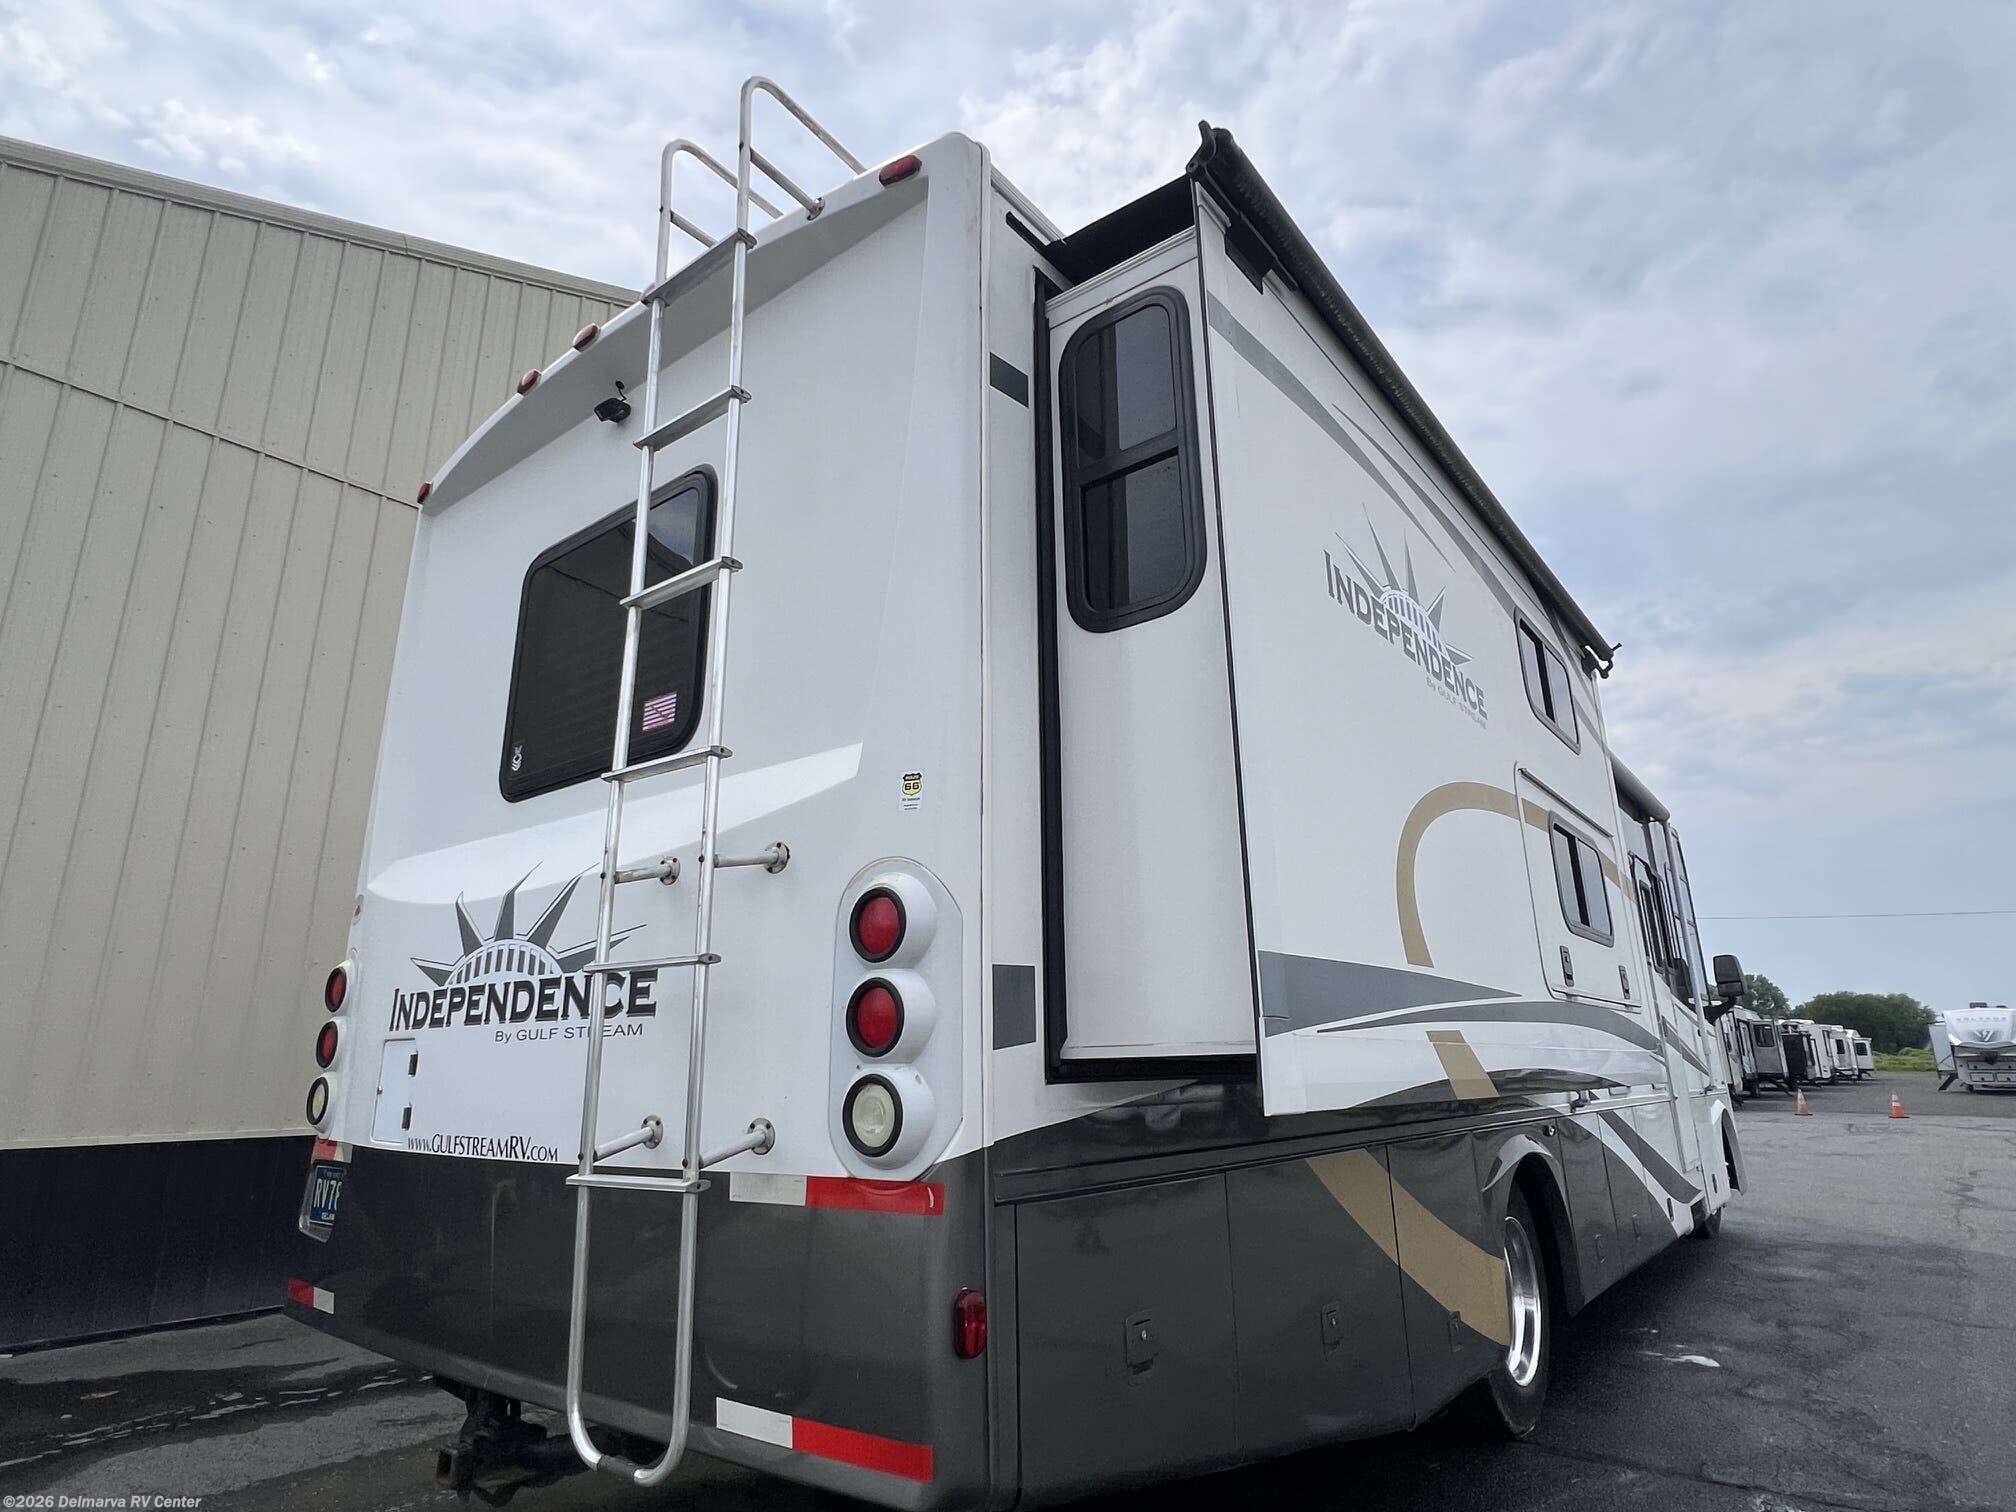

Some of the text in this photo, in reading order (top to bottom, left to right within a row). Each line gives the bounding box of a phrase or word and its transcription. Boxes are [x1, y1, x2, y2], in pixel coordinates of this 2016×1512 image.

[1324, 550, 1487, 720] INDEPENDENCE
[904, 782, 920, 790] 66
[389, 969, 659, 1032] INDEPENDENCE
[495, 1023, 643, 1044] By GULF STEAM
